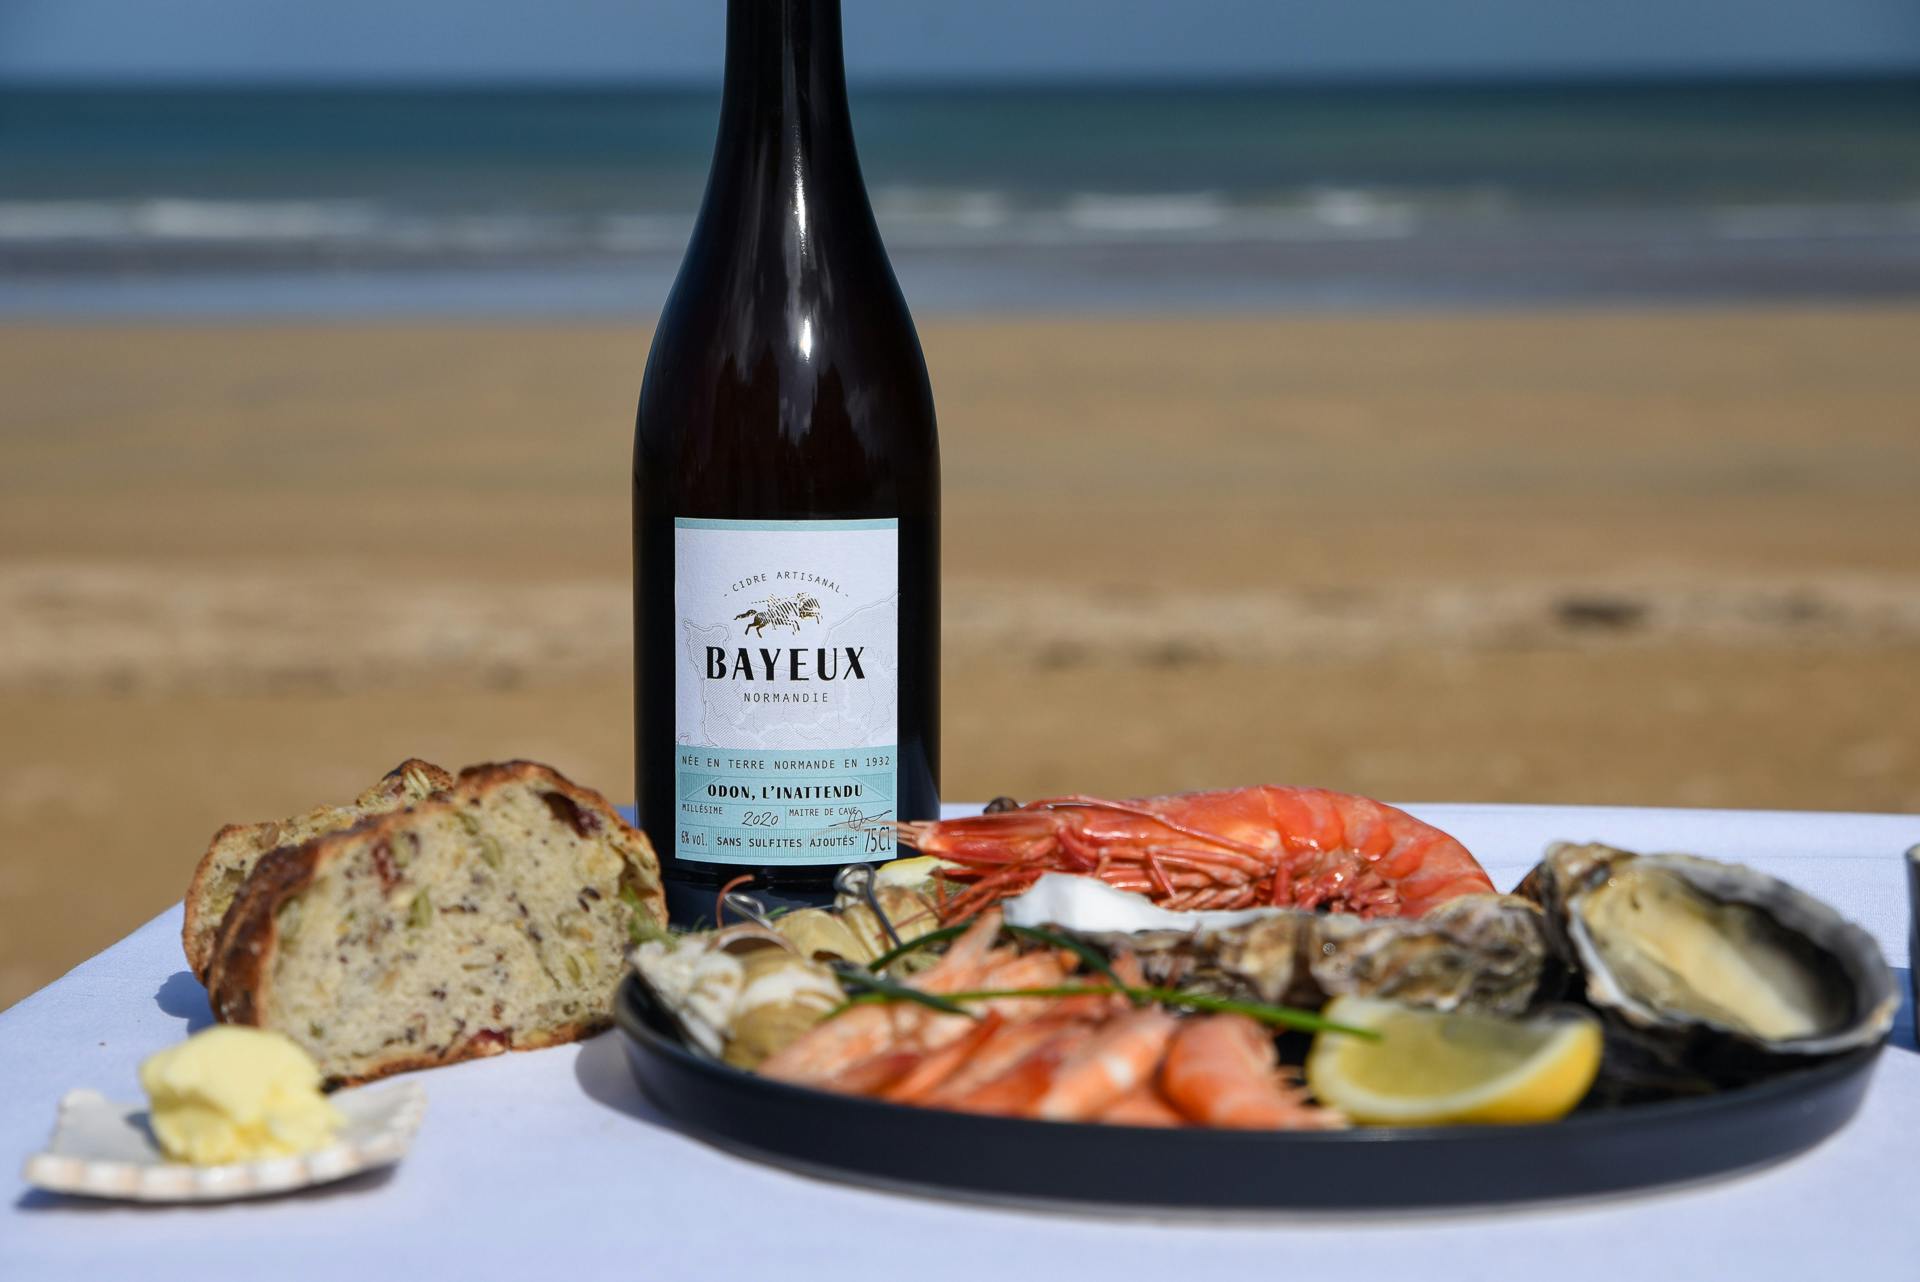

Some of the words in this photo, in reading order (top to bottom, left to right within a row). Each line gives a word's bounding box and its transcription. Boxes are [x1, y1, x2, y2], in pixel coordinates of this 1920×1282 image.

[732, 573, 768, 592] CIDRE
[776, 571, 841, 594] ARTISANAL
[706, 646, 866, 681] BAYEUX
[743, 692, 829, 703] NORMANDIE
[681, 754, 700, 767] NÉE
[707, 758, 720, 768] EN
[728, 759, 765, 770] TERRE
[774, 760, 835, 770] NORMANDE
[844, 758, 858, 768] EN
[866, 756, 890, 767] 1932
[707, 784, 756, 801] ODON,
[681, 803, 723, 815] MILLÉSIME
[824, 808, 834, 816] DE
[838, 807, 858, 816] CAVE
[741, 811, 779, 827] 2020
[716, 836, 742, 847] SANS
[748, 837, 802, 848] SULFITES
